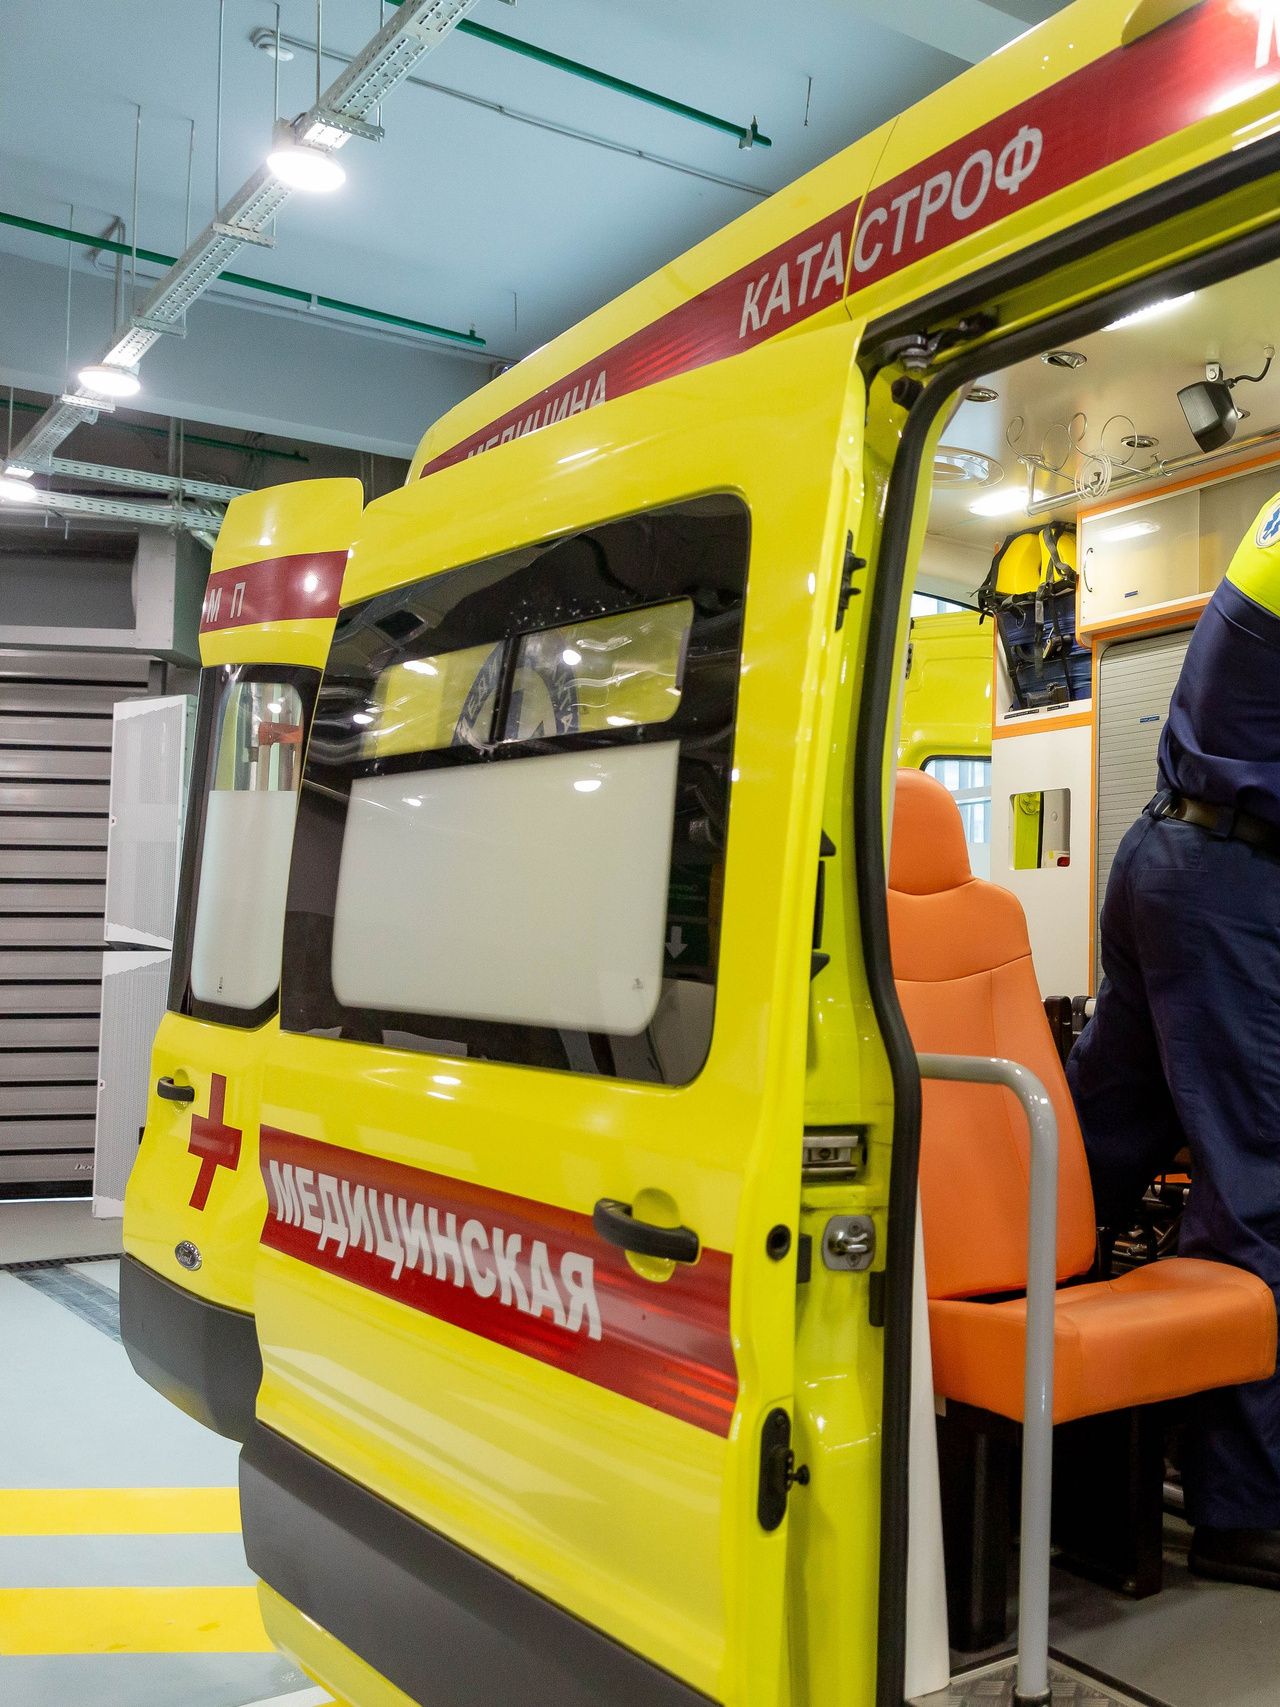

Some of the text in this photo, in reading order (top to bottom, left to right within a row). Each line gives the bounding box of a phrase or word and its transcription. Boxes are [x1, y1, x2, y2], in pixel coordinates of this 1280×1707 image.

[739, 125, 1043, 339] КАТАСТРОФ
[230, 582, 246, 618] П
[269, 1160, 602, 1341] МЕДИЦИНСКАЯ
